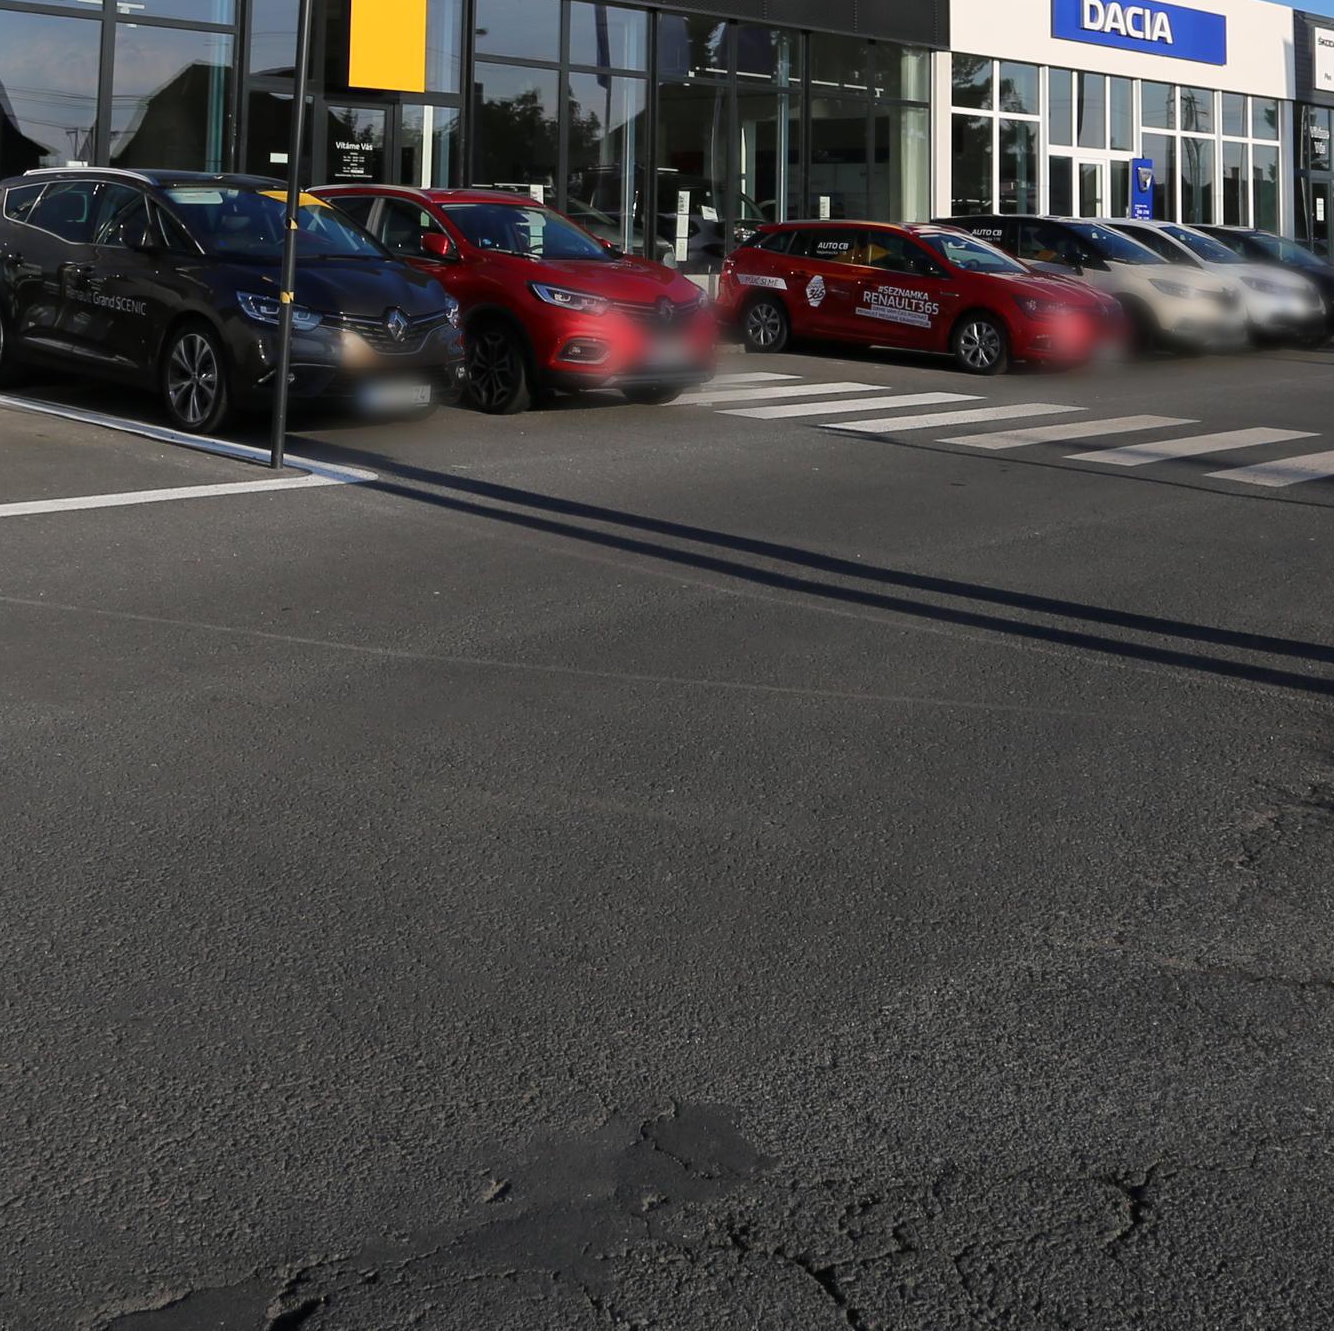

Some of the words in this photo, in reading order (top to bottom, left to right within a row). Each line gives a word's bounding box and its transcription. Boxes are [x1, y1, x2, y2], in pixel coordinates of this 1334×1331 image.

[336, 141, 360, 150] Vítáme
[361, 142, 373, 151] Vás
[817, 242, 838, 250] AUTO
[838, 242, 849, 251] CB
[877, 286, 929, 301] #SEZNAMKA
[92, 291, 116, 308] Grand
[115, 296, 147, 316] SCENIC
[863, 291, 940, 315] RENAULT365
